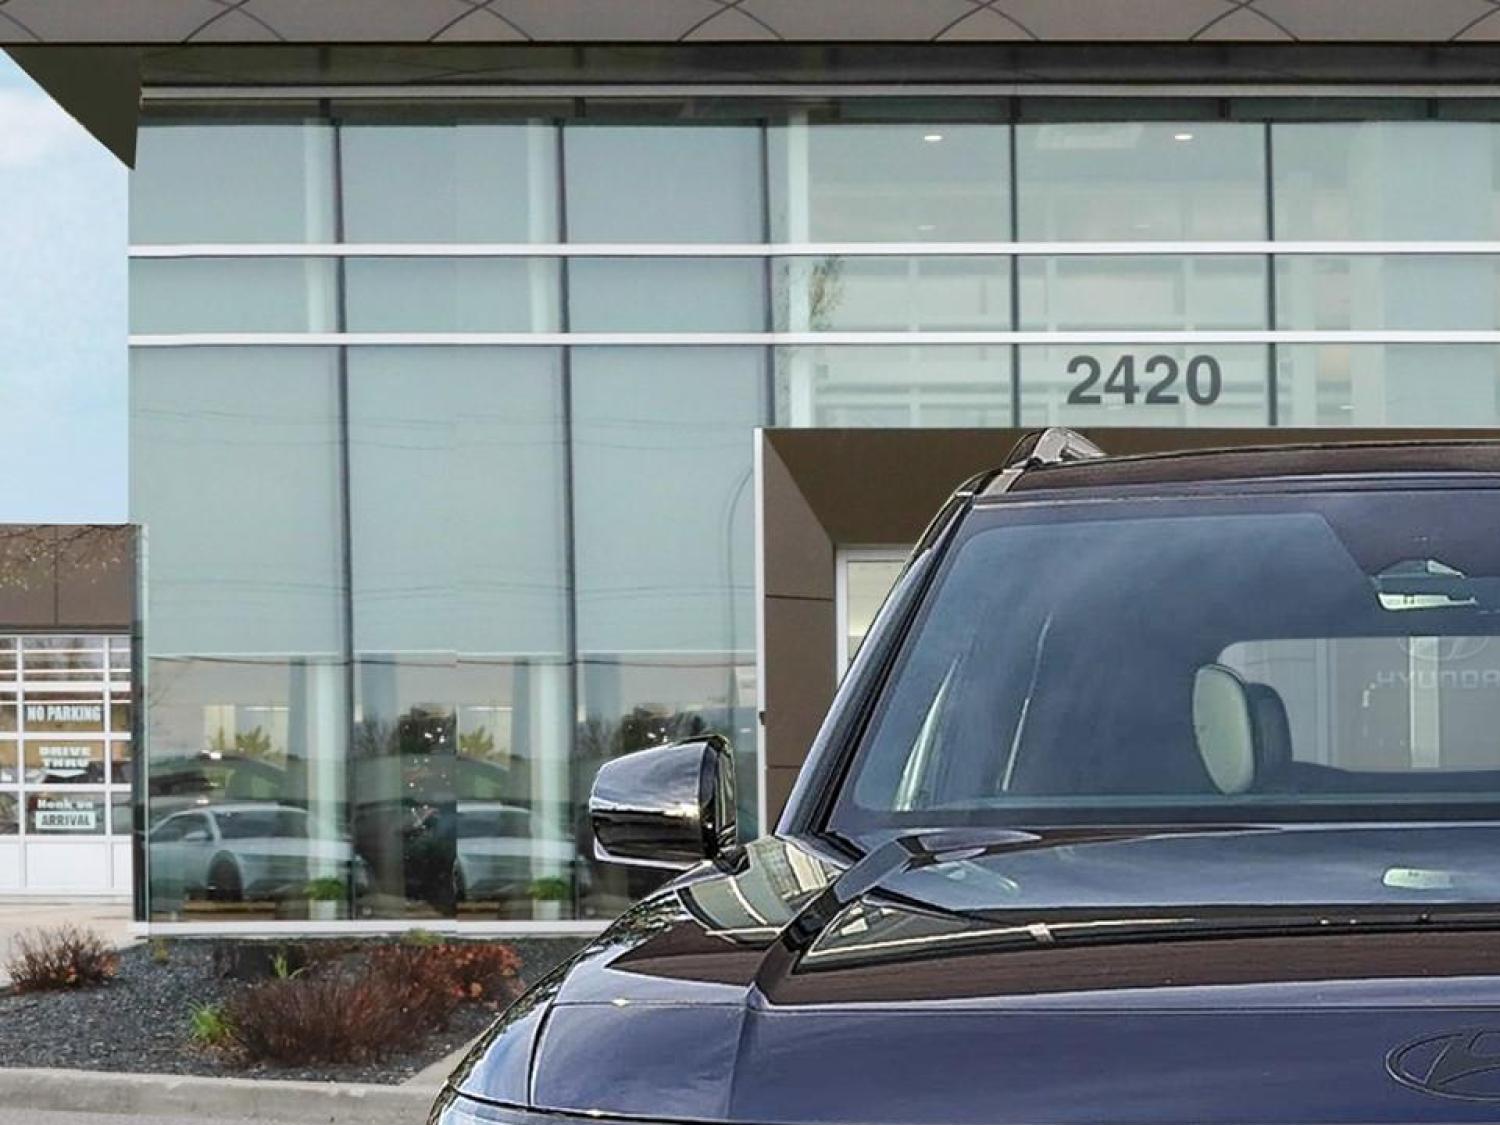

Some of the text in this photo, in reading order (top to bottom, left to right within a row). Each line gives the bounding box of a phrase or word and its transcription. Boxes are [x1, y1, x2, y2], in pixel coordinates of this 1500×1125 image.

[1066, 354, 1222, 405] 2420
[27, 705, 100, 721] NO PARKING
[41, 813, 91, 826] ARRIVAL
